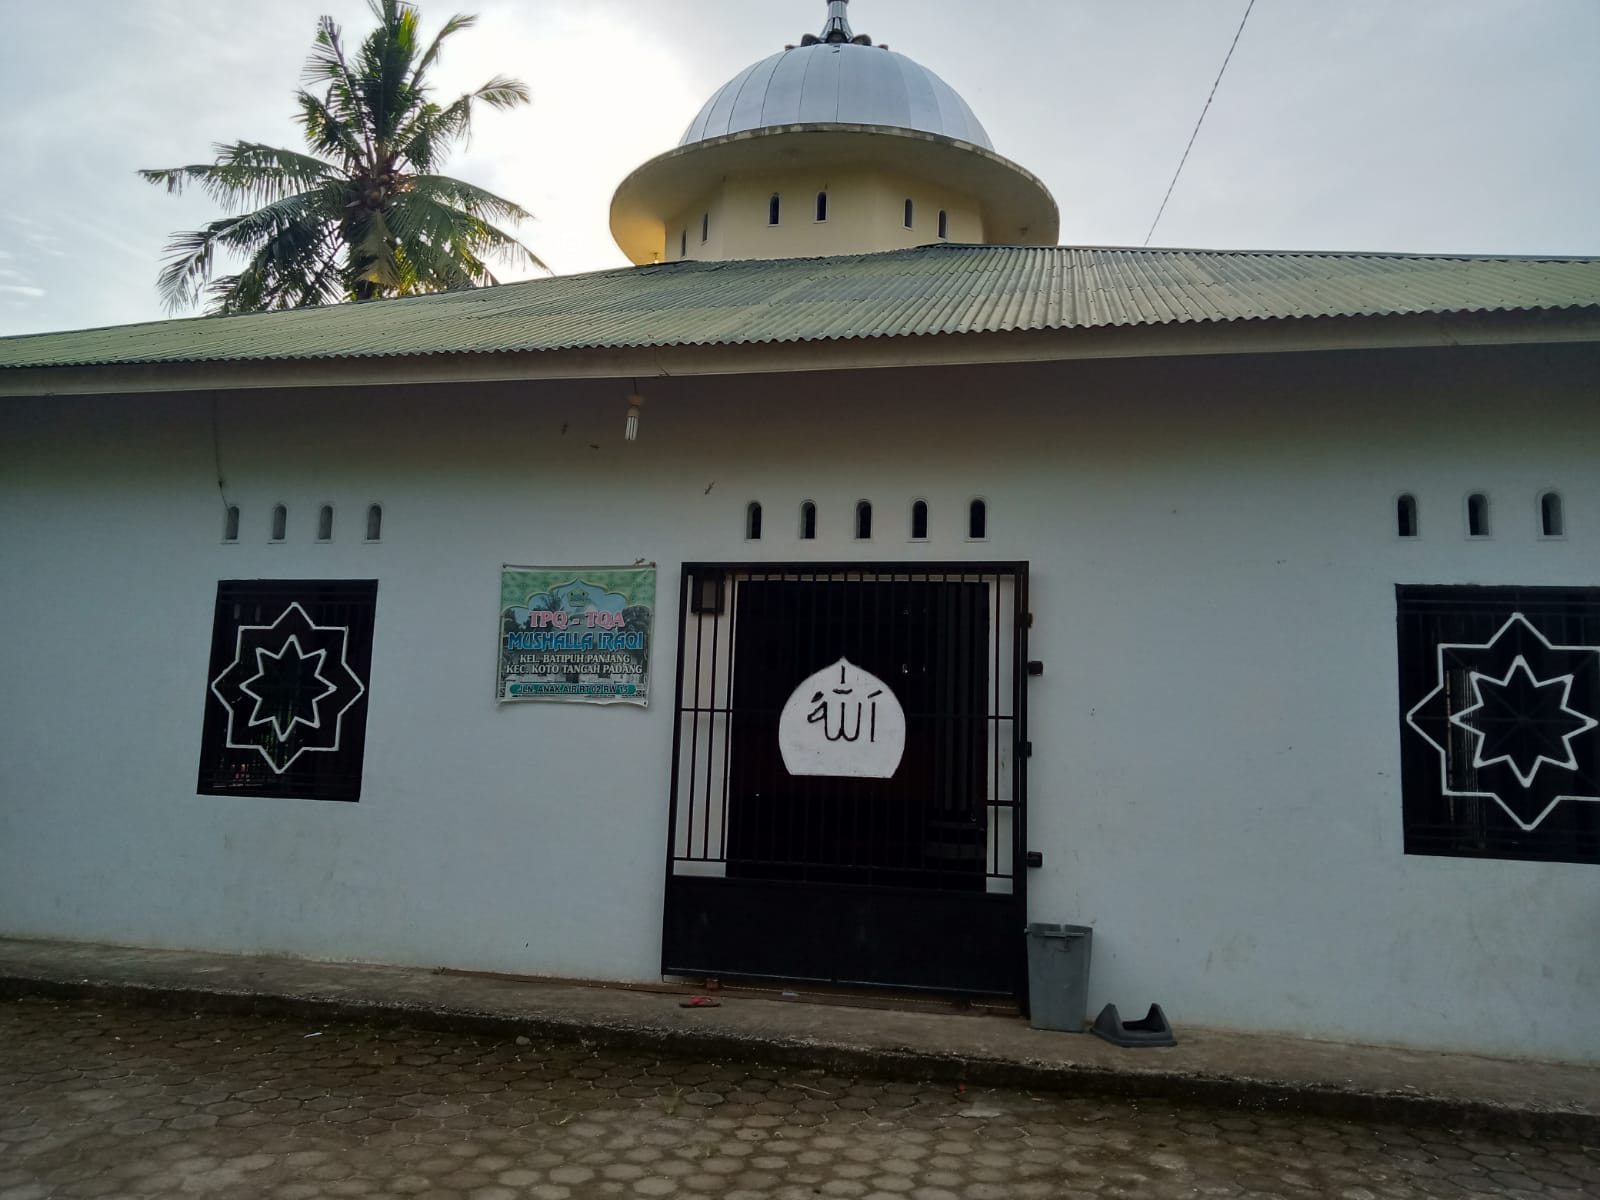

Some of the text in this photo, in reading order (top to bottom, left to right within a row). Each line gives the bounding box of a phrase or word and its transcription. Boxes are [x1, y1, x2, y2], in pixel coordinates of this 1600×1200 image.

[529, 610, 568, 629] TPQ
[586, 611, 625, 629] TQA
[508, 632, 643, 651] MUSHALLA IRAQI
[520, 654, 630, 663] KEL. BATIPUH PANJANG
[506, 664, 642, 674] KEC. KOTO TANGAH PADANG
[539, 684, 560, 693] ANAK
[564, 685, 577, 693] AIR
[579, 685, 589, 693] RT
[604, 685, 617, 693] RW
